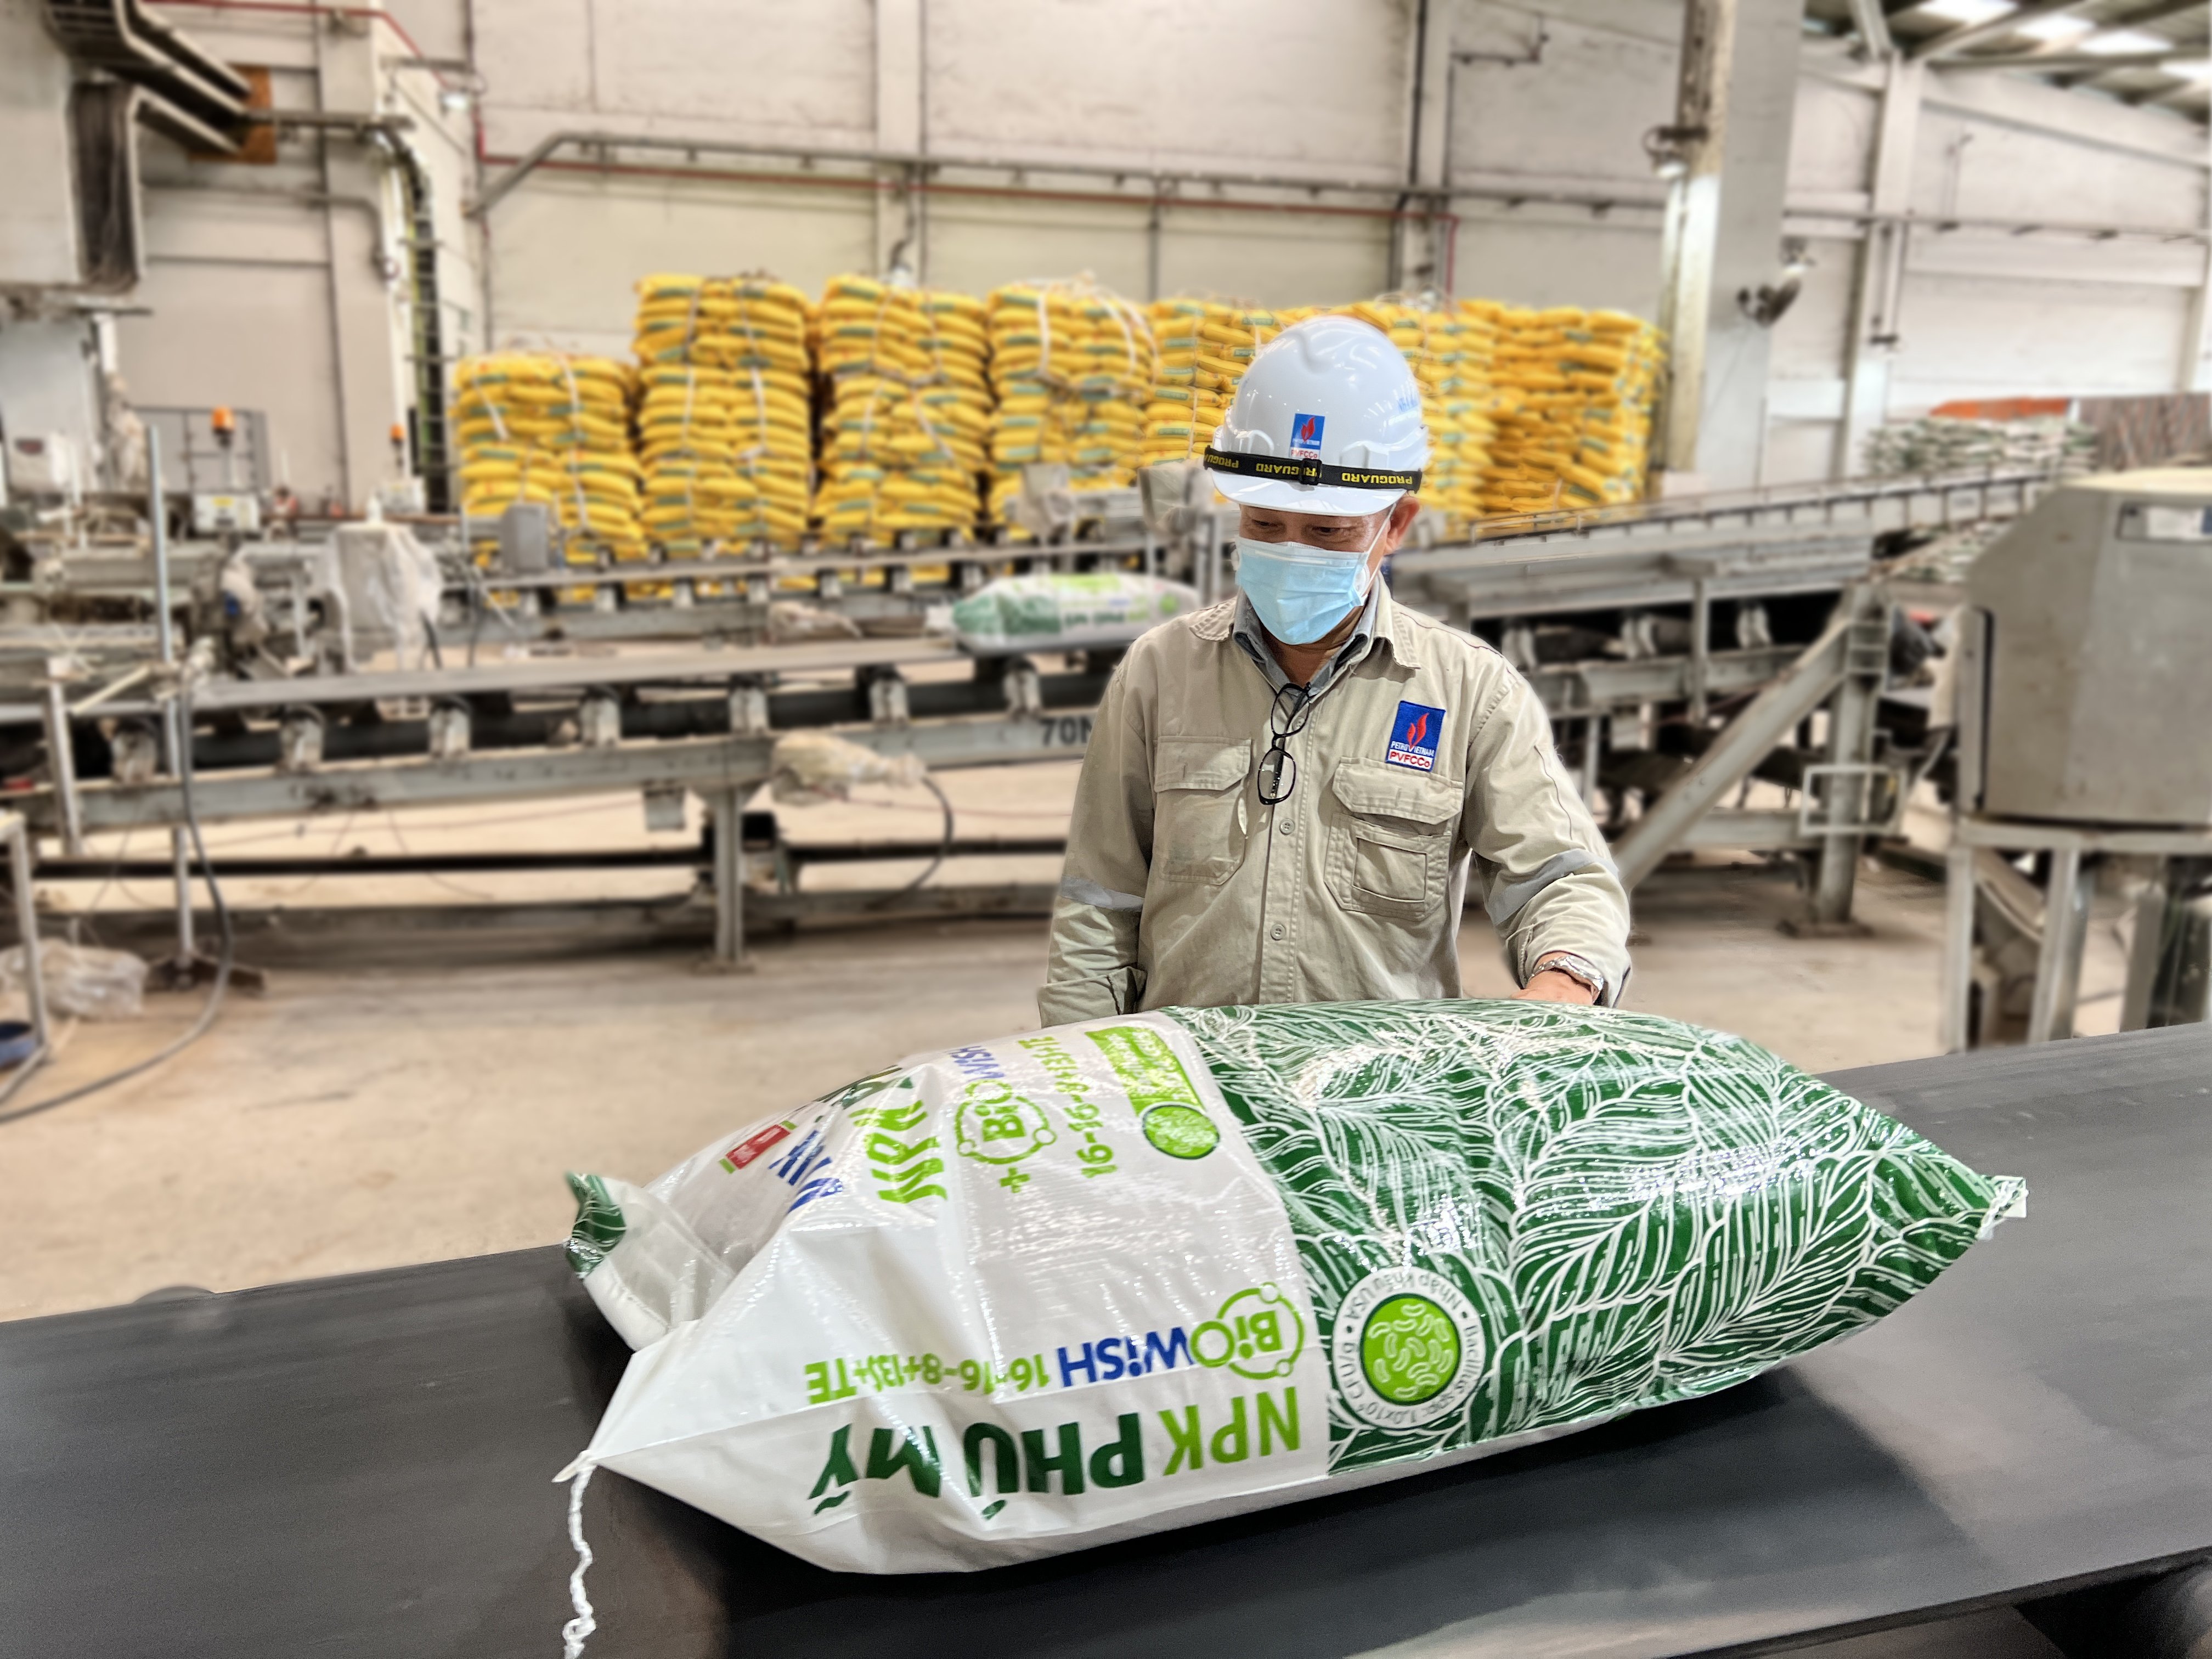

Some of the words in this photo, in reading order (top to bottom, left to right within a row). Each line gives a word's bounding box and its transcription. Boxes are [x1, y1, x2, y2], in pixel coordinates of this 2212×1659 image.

[1256, 463, 1322, 478] RGUARD
[1341, 472, 1413, 484] PROGUARD
[1391, 741, 1435, 757] PETROVIETNAM
[1390, 751, 1430, 768] PVFCCo
[1156, 1386, 1302, 1476] NPK
[808, 1422, 943, 1516] MỸ
[963, 1412, 1146, 1521] PHÚ
